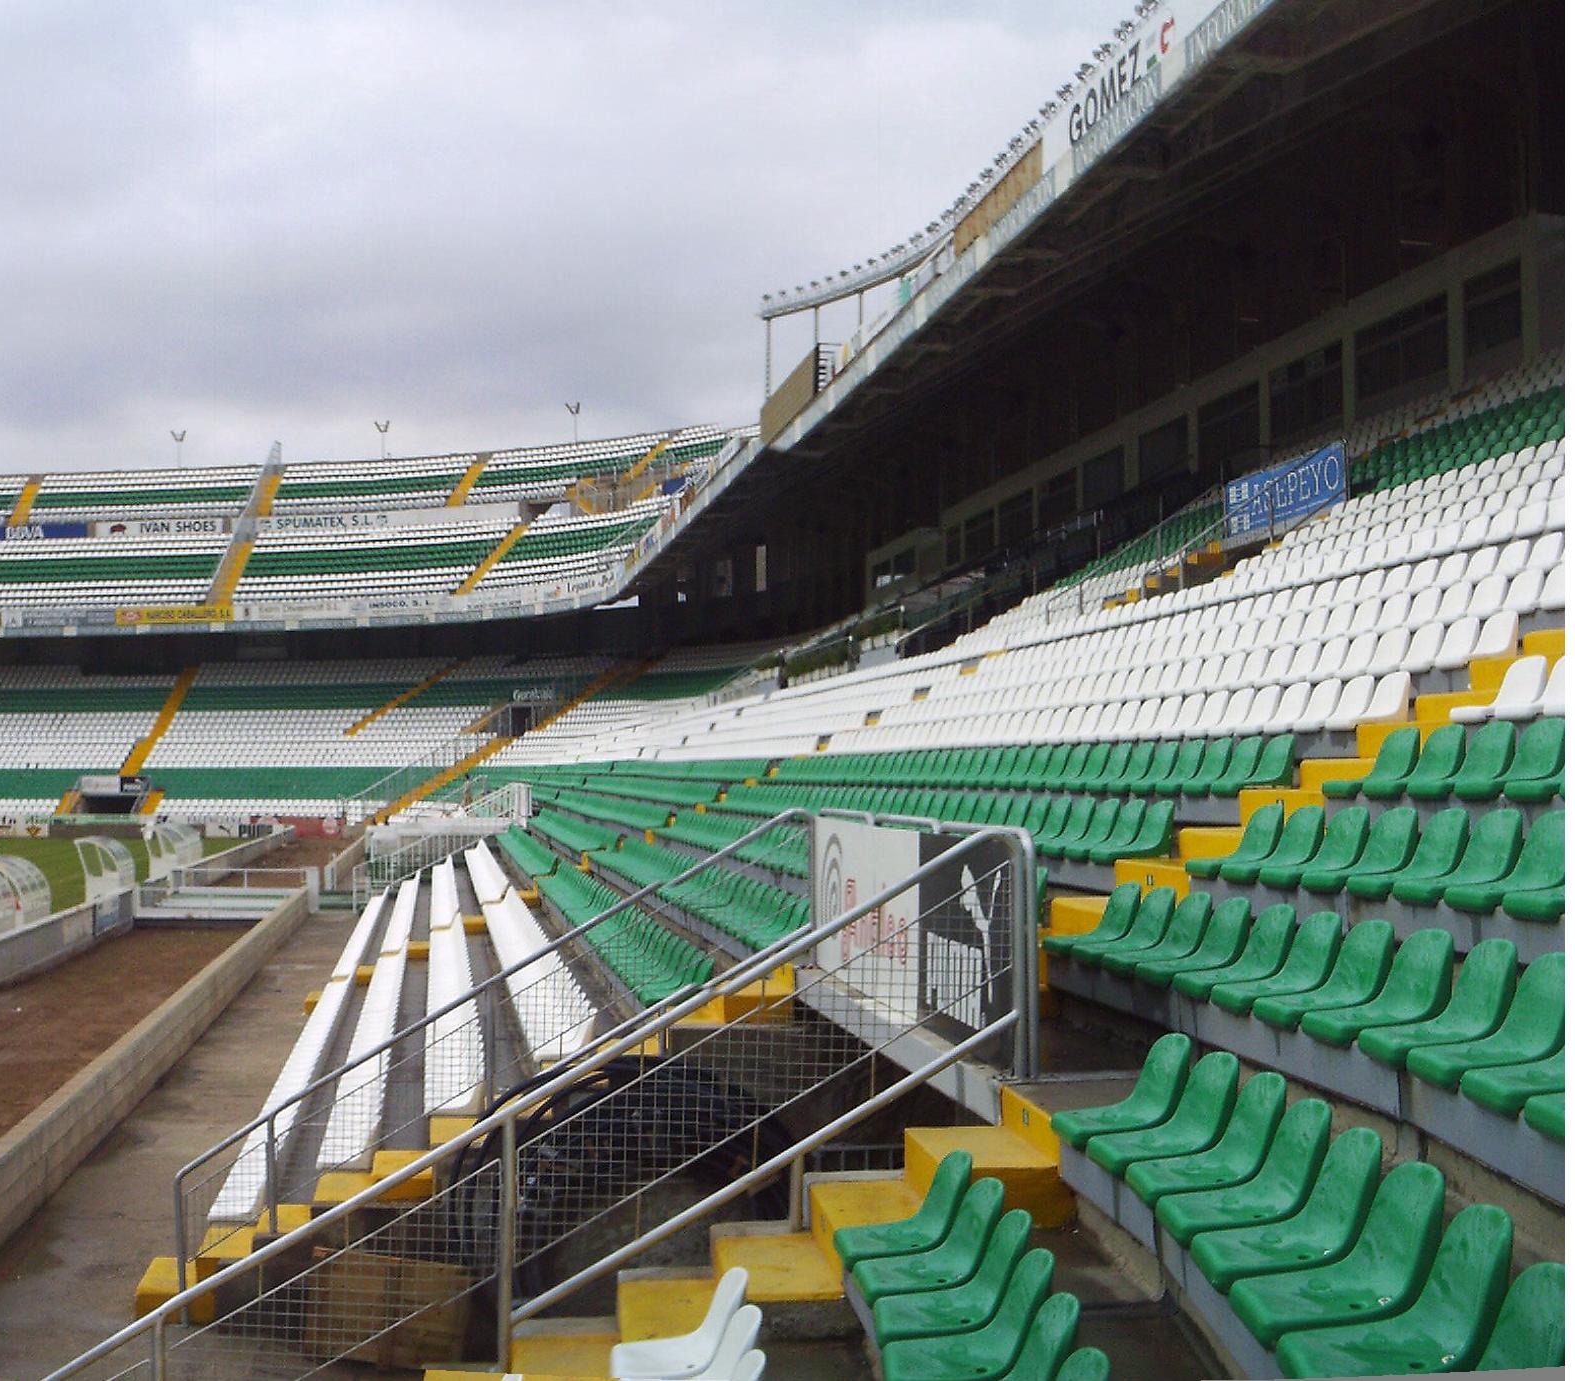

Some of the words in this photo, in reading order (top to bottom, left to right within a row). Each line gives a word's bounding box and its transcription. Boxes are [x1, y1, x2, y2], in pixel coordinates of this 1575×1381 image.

[1068, 38, 1144, 144] GOMEZ
[1251, 455, 1340, 517] ASEPEYO
[139, 522, 171, 534] IVAN
[175, 520, 217, 533] SHOES
